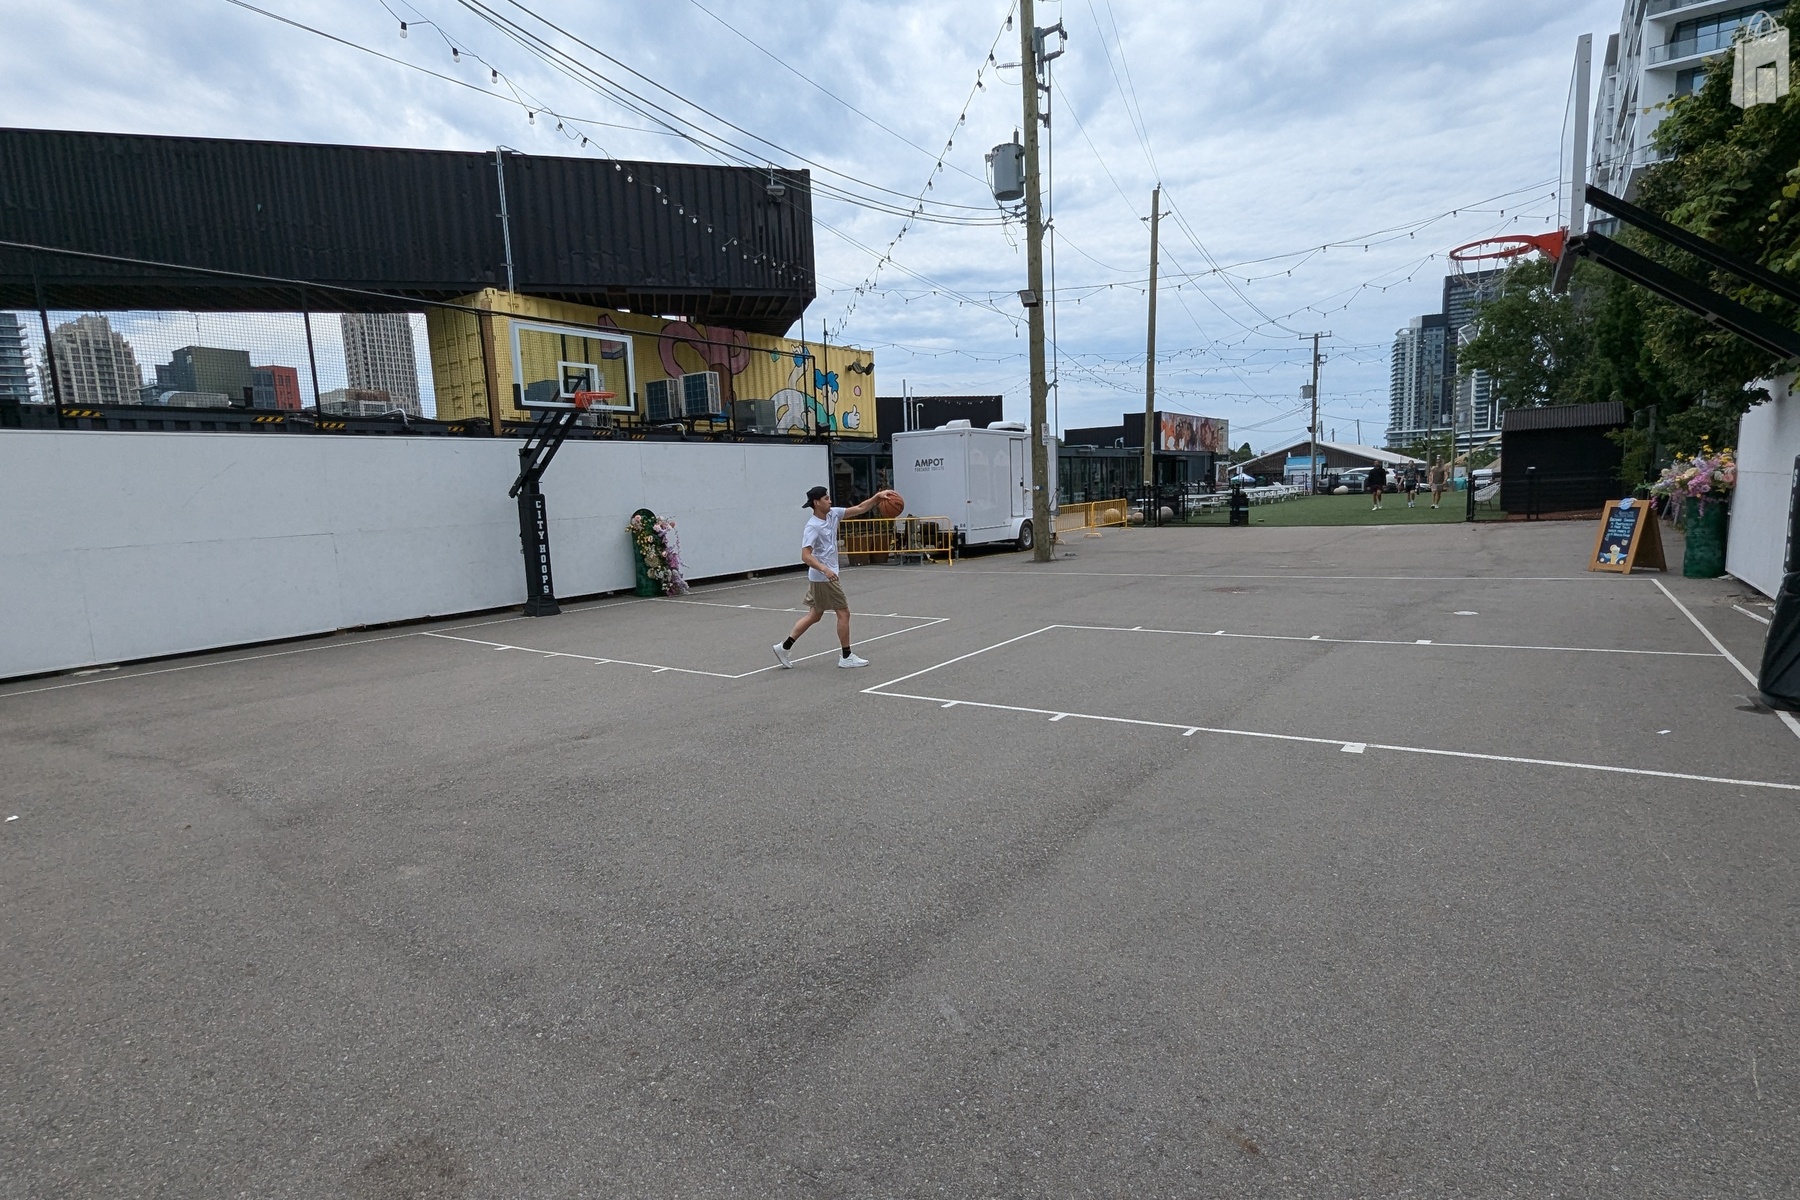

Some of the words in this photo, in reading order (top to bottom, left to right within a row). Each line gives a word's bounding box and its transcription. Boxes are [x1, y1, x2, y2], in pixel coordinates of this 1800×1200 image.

[915, 458, 944, 467] AMPOT
[536, 501, 545, 539] CITY
[539, 544, 549, 593] HOOPS
